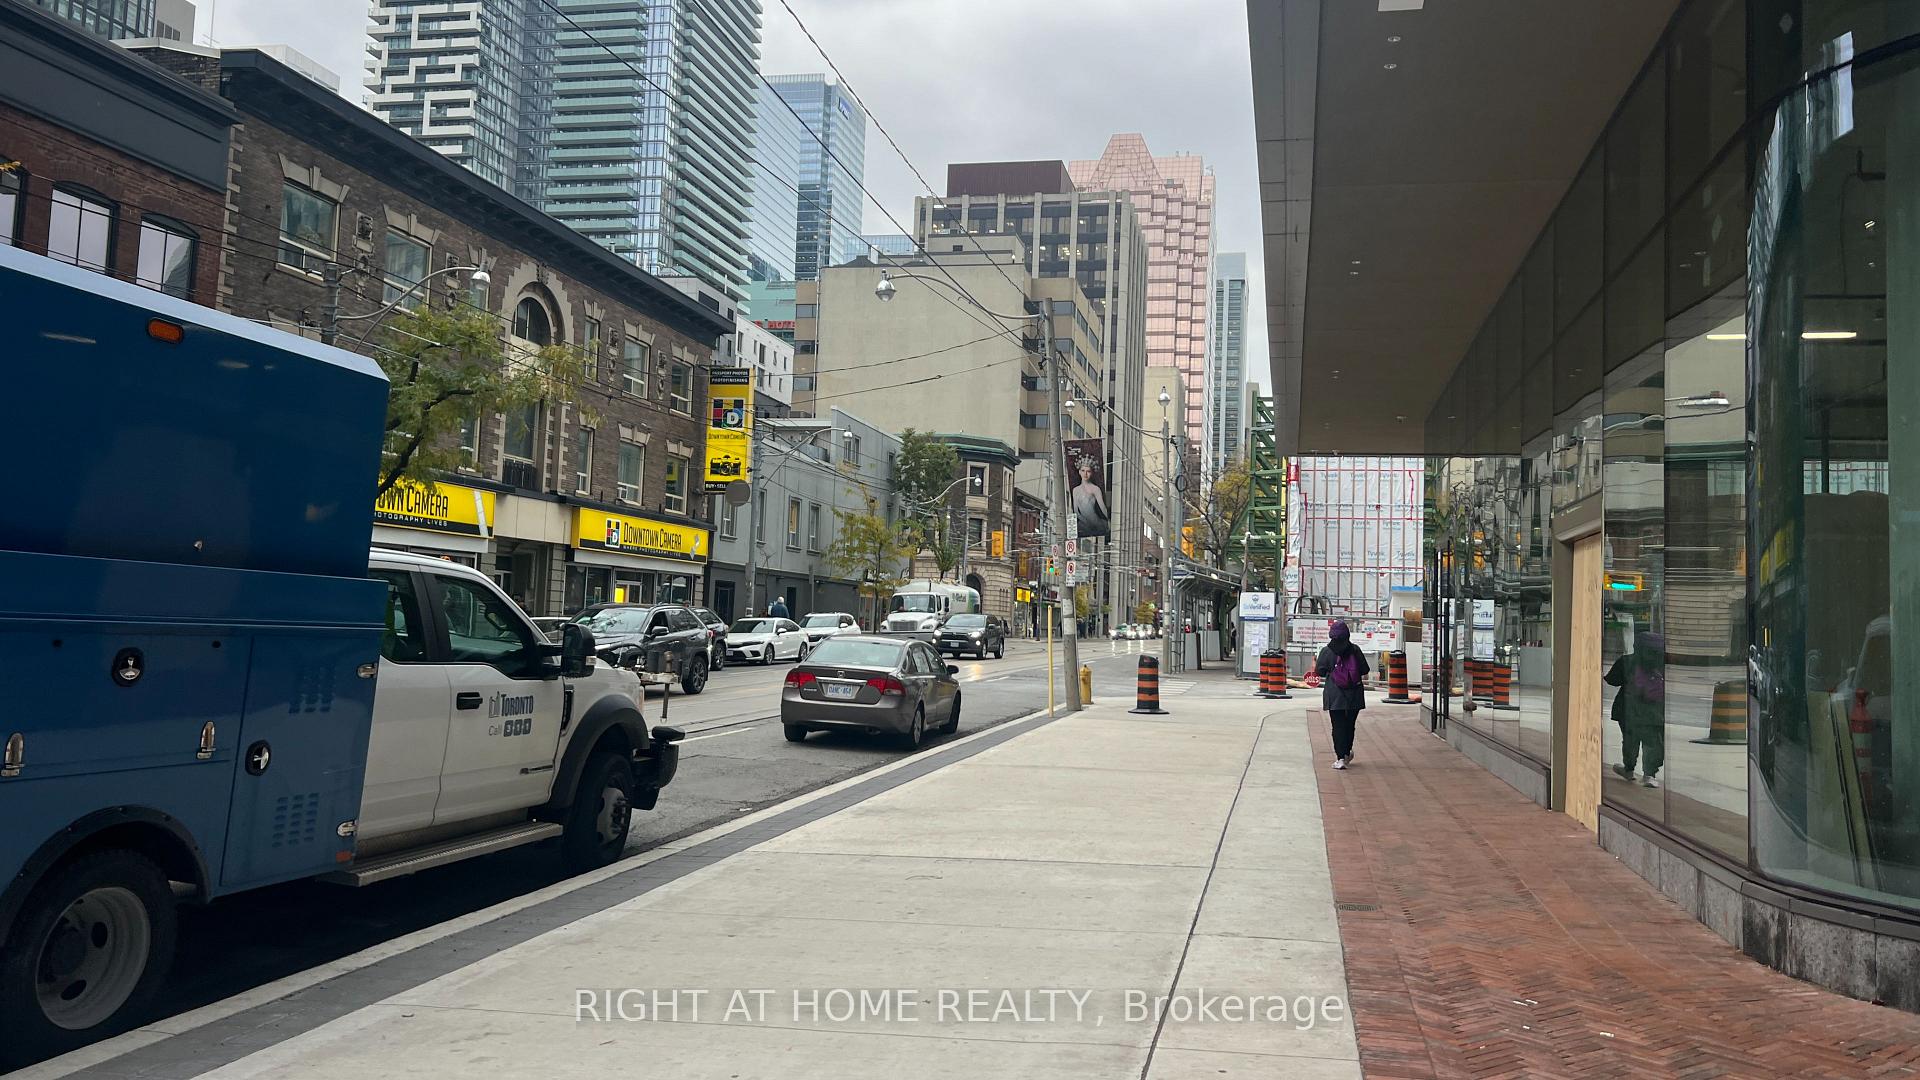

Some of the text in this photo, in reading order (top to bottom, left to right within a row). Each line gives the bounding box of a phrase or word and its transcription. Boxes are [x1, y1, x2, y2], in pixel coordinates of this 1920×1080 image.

[406, 485, 449, 518] CAMERA
[427, 518, 448, 527] LIVES
[623, 522, 659, 547] DOWNTOWN
[659, 528, 682, 550] CAMERA
[501, 693, 534, 717] TORONTO
